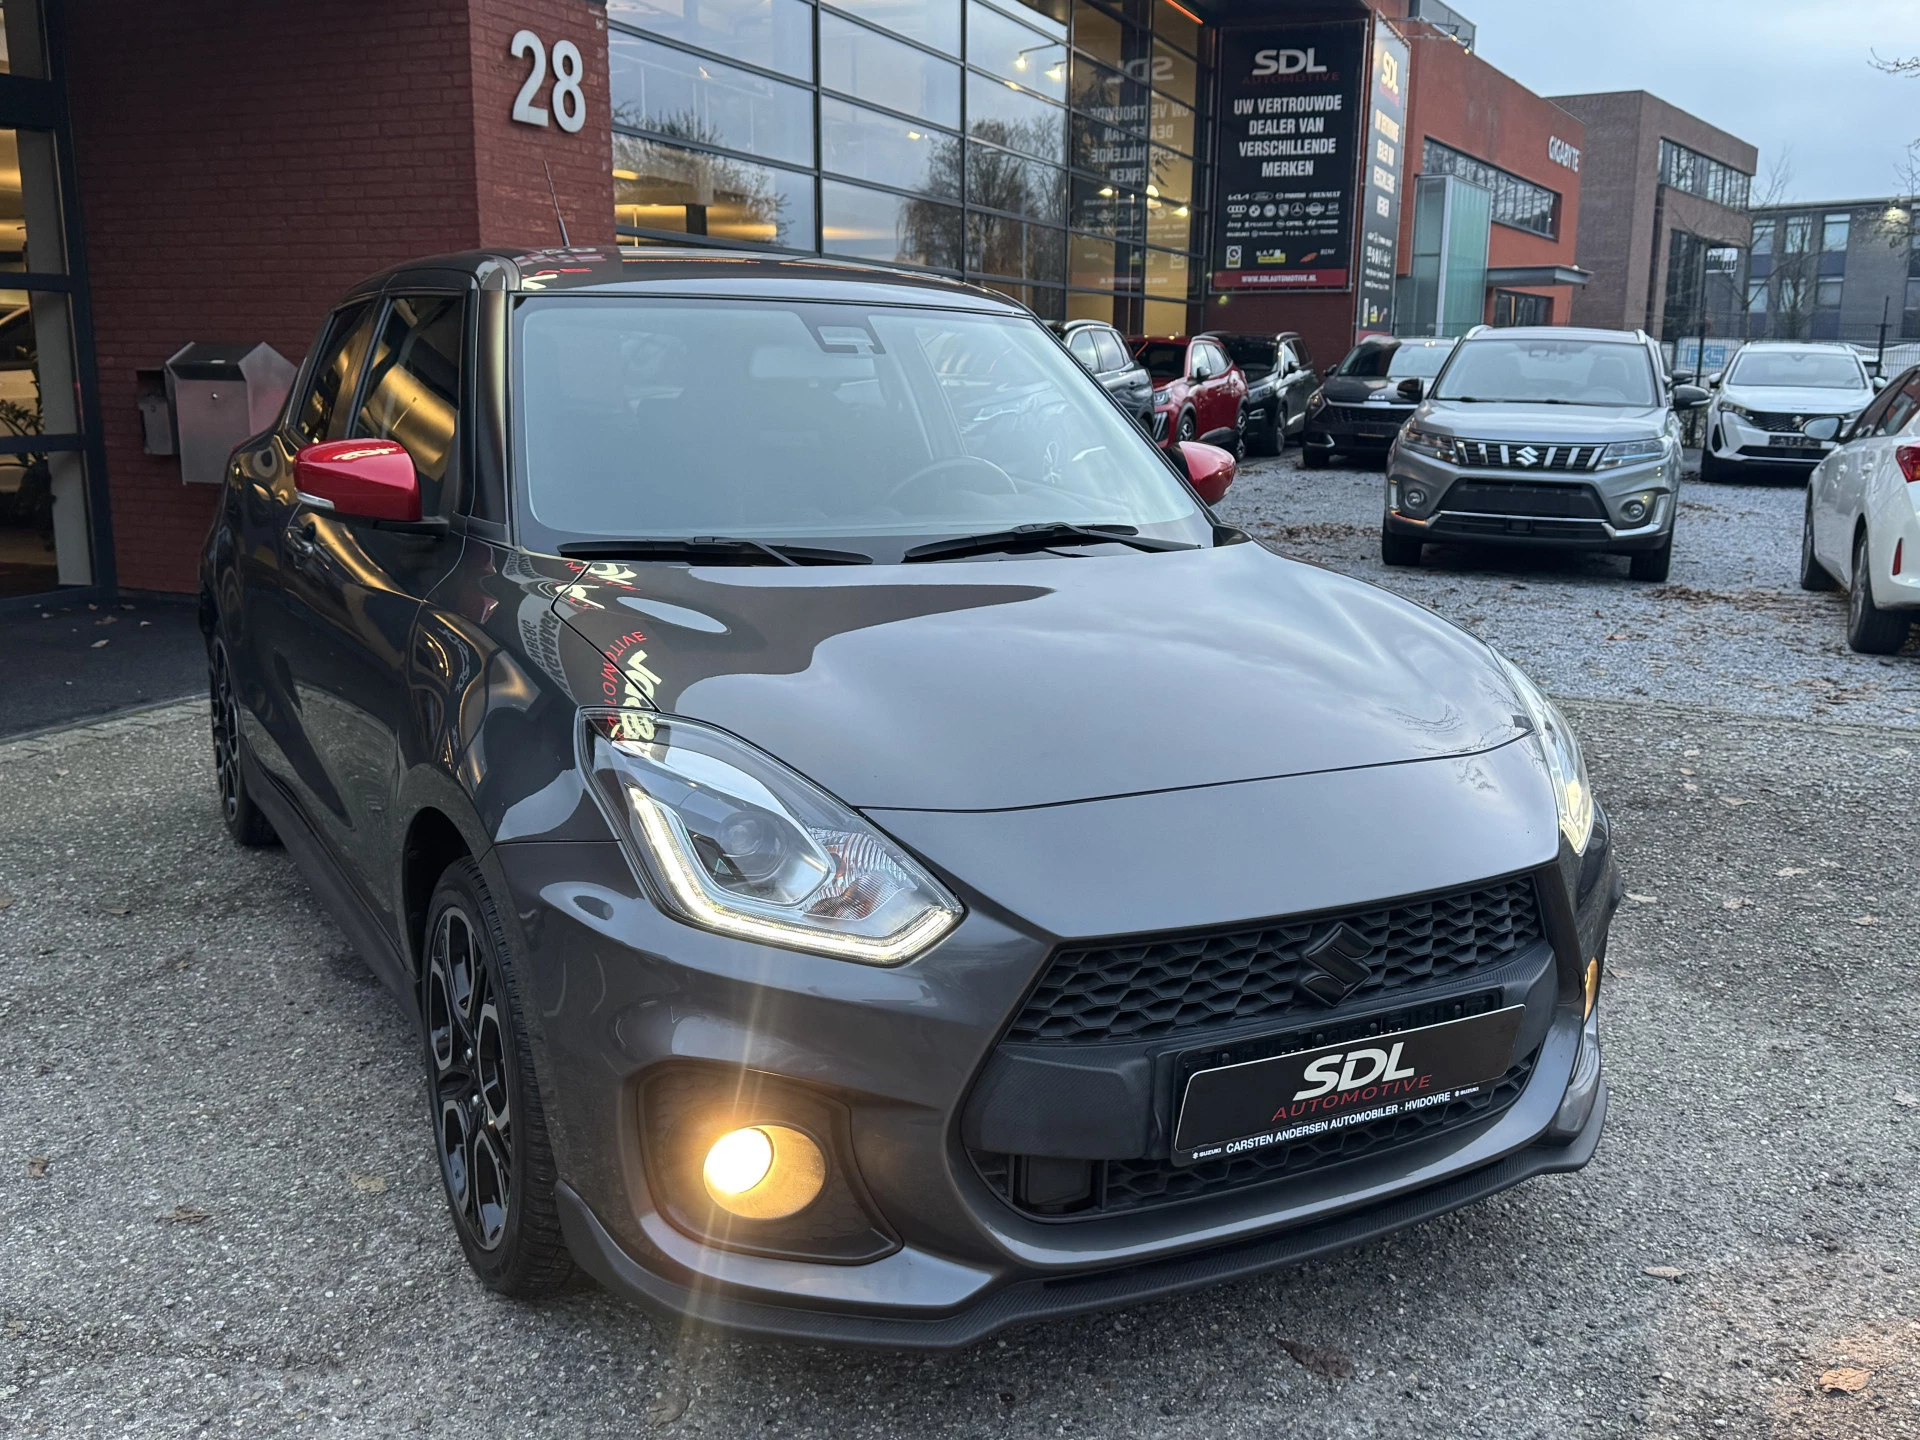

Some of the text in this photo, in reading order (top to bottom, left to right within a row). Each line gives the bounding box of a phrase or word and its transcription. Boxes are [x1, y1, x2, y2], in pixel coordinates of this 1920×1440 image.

[1252, 48, 1327, 75] SDL
[511, 29, 586, 133] 28
[1242, 72, 1340, 85] AUTOMOTIVE
[1234, 95, 1342, 115] UW VERTROUWDE
[1249, 117, 1324, 135] DEALER VAN
[1239, 138, 1336, 157] VERSCHILLENDE
[1262, 160, 1314, 177] MERKEN
[1293, 1042, 1415, 1101] SDL
[1271, 1075, 1433, 1121] AUTOMOTIVE
[1199, 1147, 1222, 1157] SUZUKI
[1226, 1133, 1274, 1153] CARSTEN
[1275, 1122, 1328, 1142] ANDERSEN
[1330, 1105, 1398, 1129] AUTOMOBILER
[1405, 1092, 1451, 1111] HVIDOVRE
